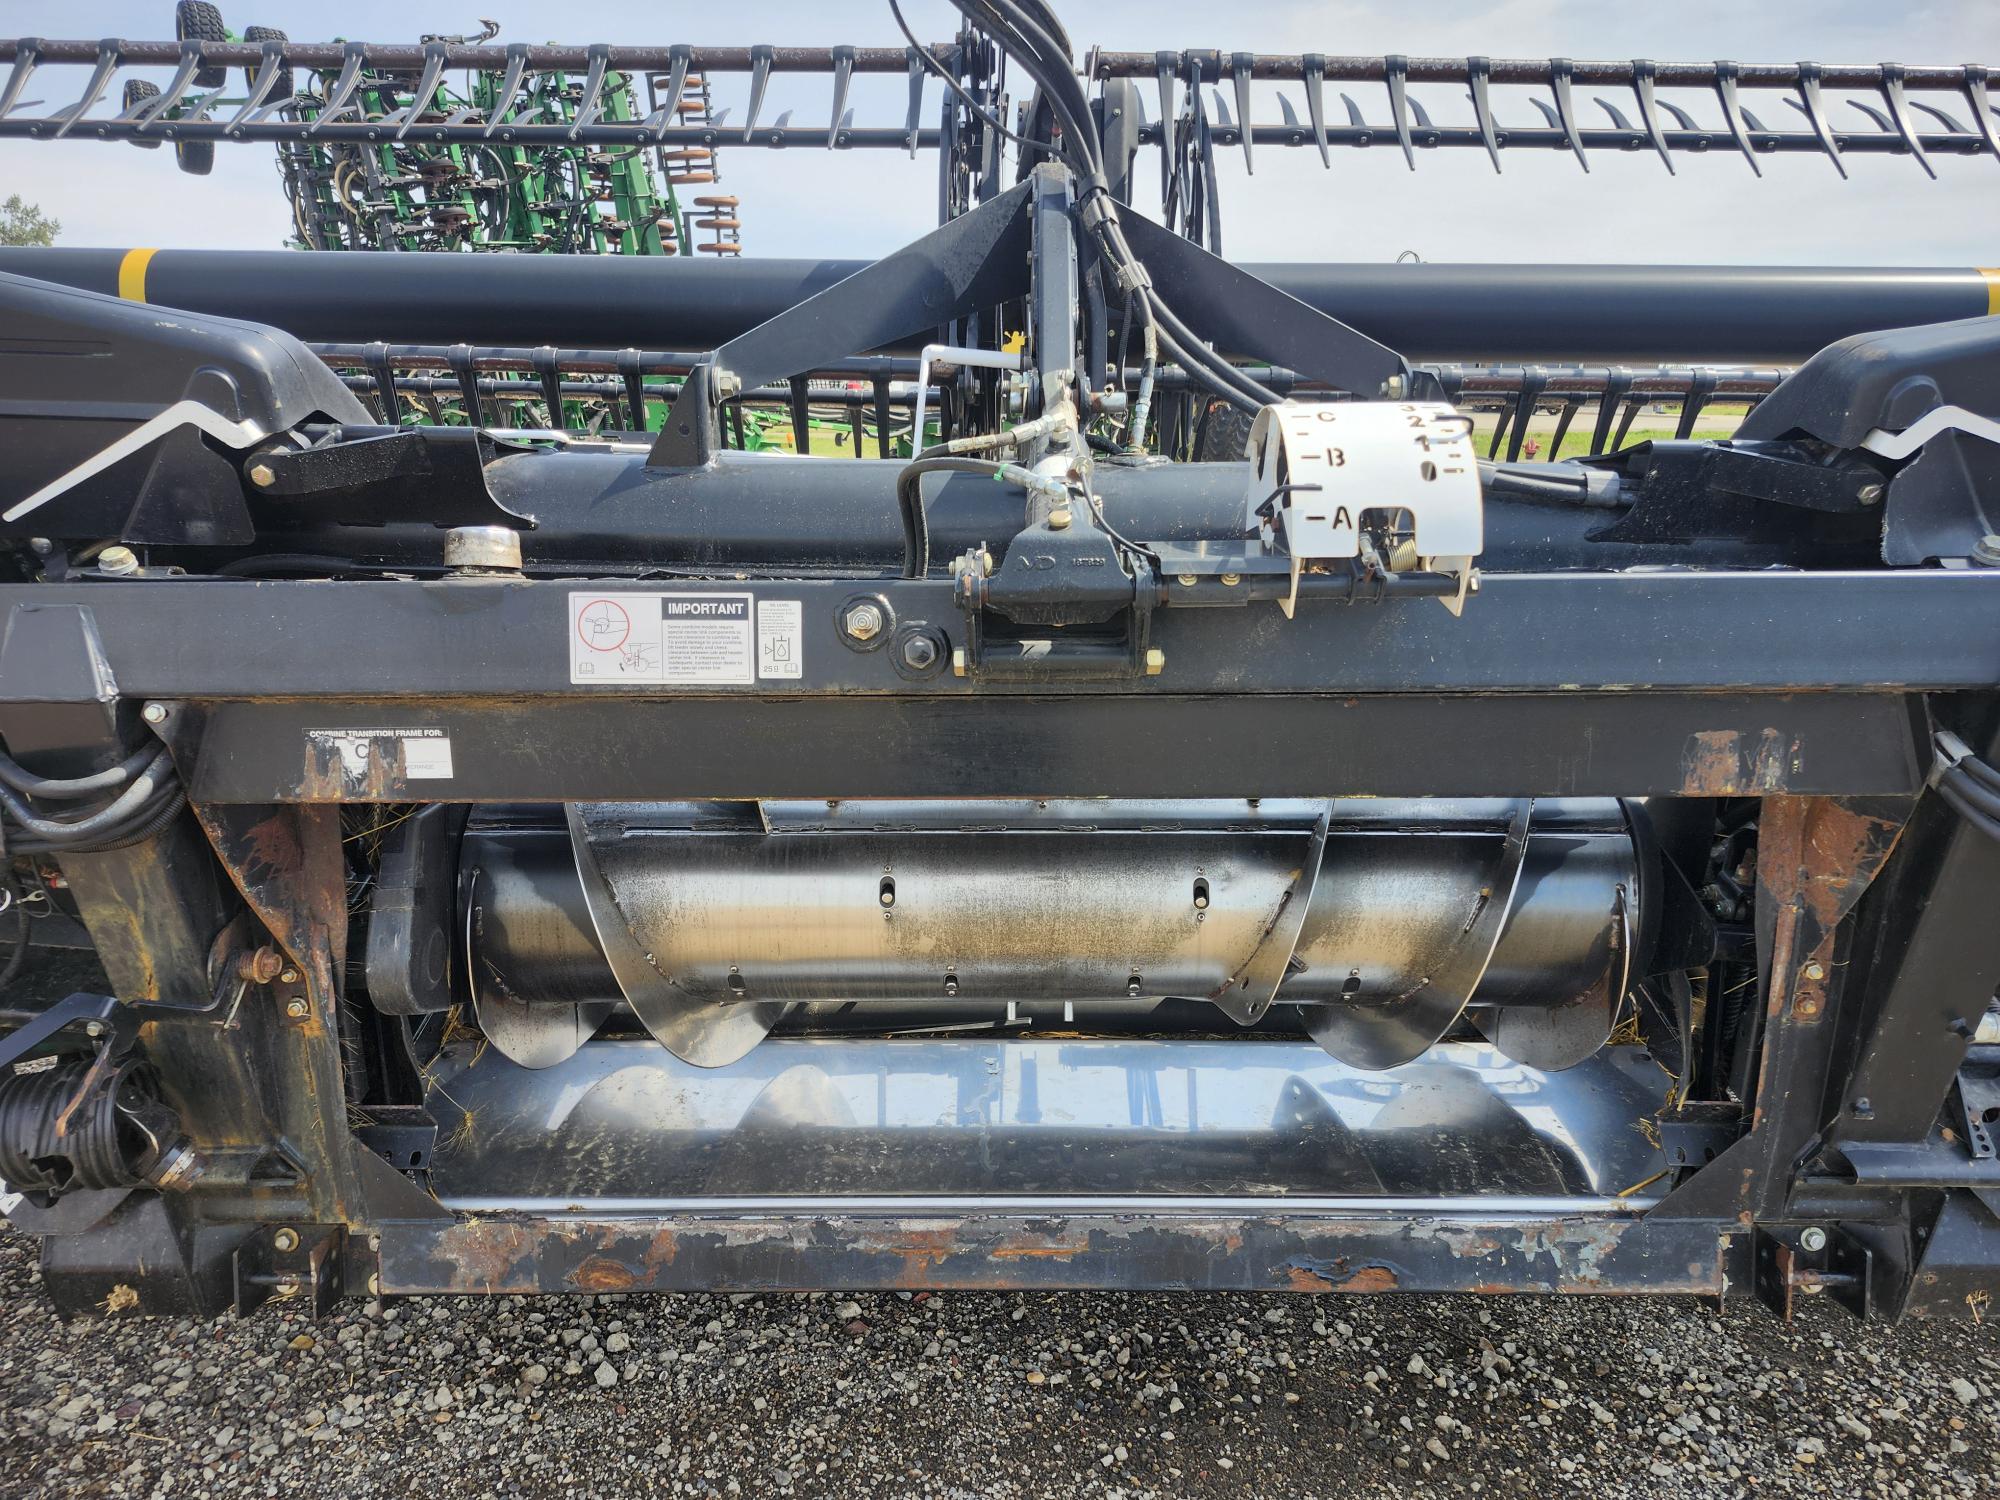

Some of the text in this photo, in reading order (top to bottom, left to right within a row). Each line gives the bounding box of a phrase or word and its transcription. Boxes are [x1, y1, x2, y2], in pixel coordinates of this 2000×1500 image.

[1399, 404, 1416, 412] 3
[1316, 411, 1336, 422] C
[1406, 415, 1426, 427] 2
[1414, 434, 1431, 452] 1
[1327, 447, 1345, 467] B
[1332, 505, 1352, 530] A
[668, 602, 744, 615] IMPORTANT
[424, 729, 443, 737] FOR:
